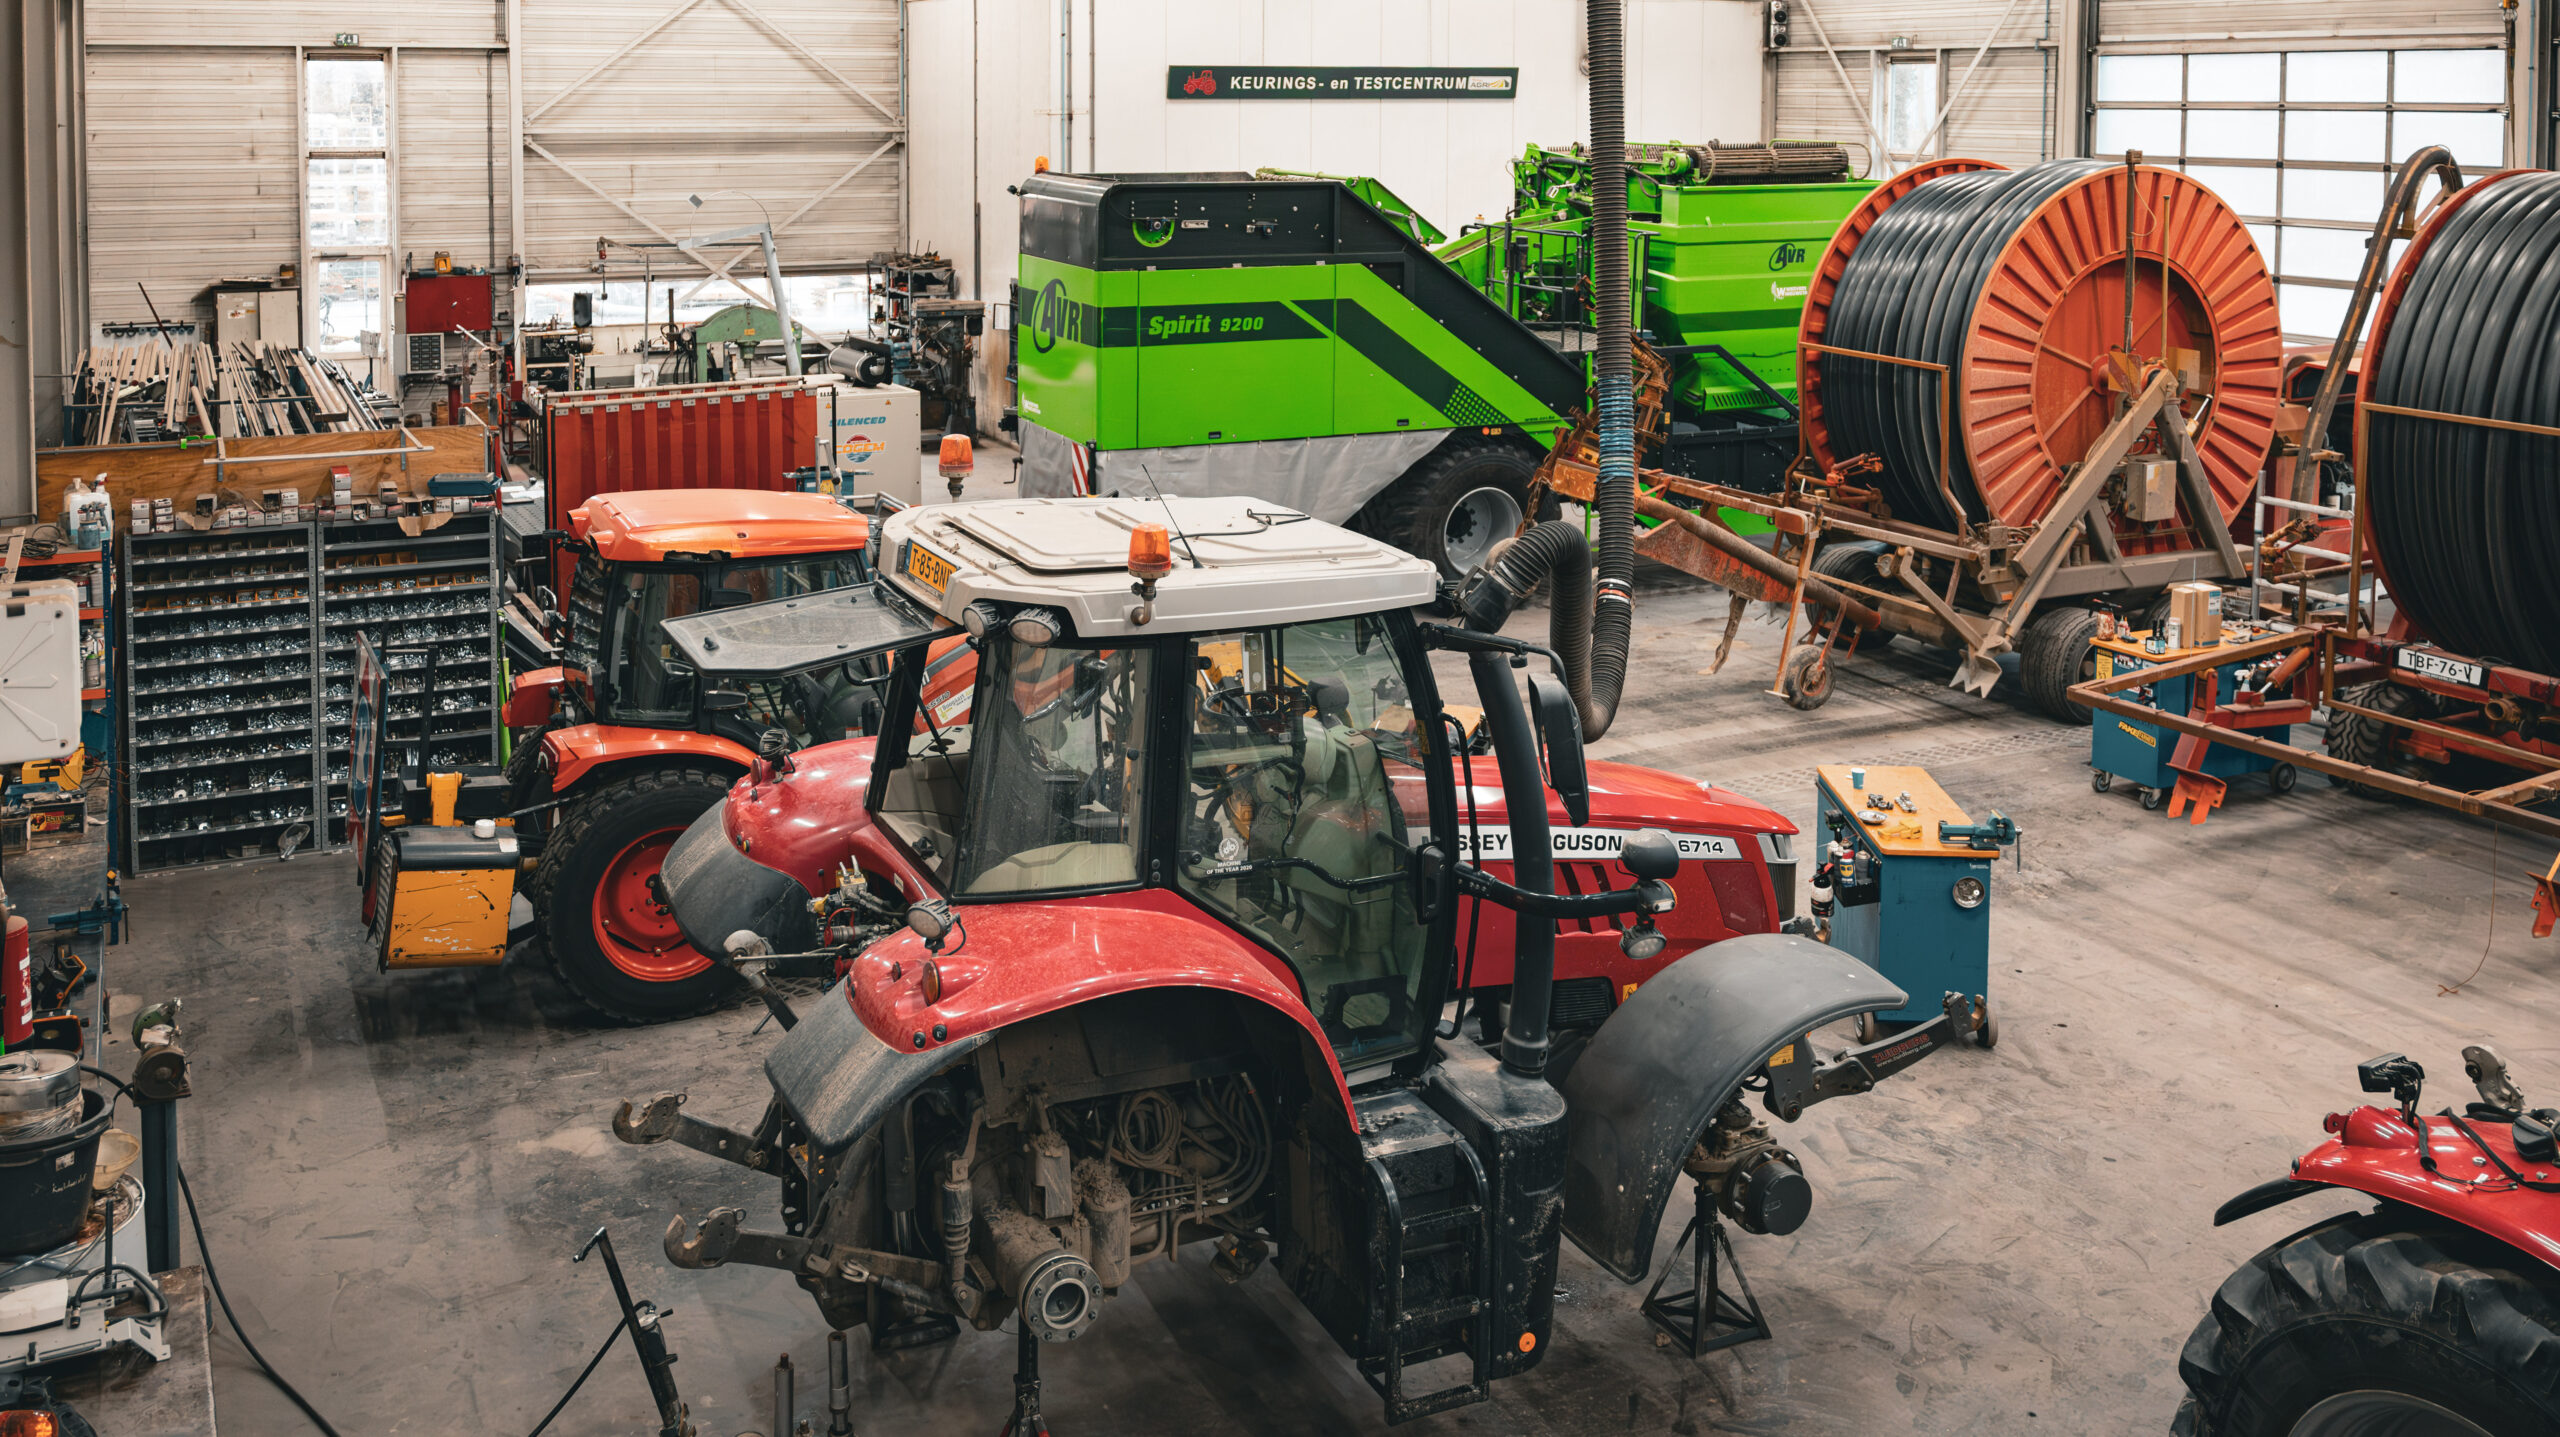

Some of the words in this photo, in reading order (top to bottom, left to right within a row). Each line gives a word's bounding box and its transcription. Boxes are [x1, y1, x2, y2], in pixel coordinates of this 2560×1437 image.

[1330, 79, 1349, 90] en
[1353, 76, 1467, 90] TESTCENTRUM
[1768, 243, 1805, 271] AVR
[1033, 278, 1082, 354] AVR
[1148, 314, 1211, 339] Spirit
[1219, 316, 1264, 332] 9200
[2407, 652, 2472, 680] TBF-76-V
[1553, 834, 1622, 851] GUSON
[1678, 839, 1724, 854] 6714
[1217, 860, 1241, 868] MACHINE
[1872, 1033, 1929, 1063] ZUIDBERG
